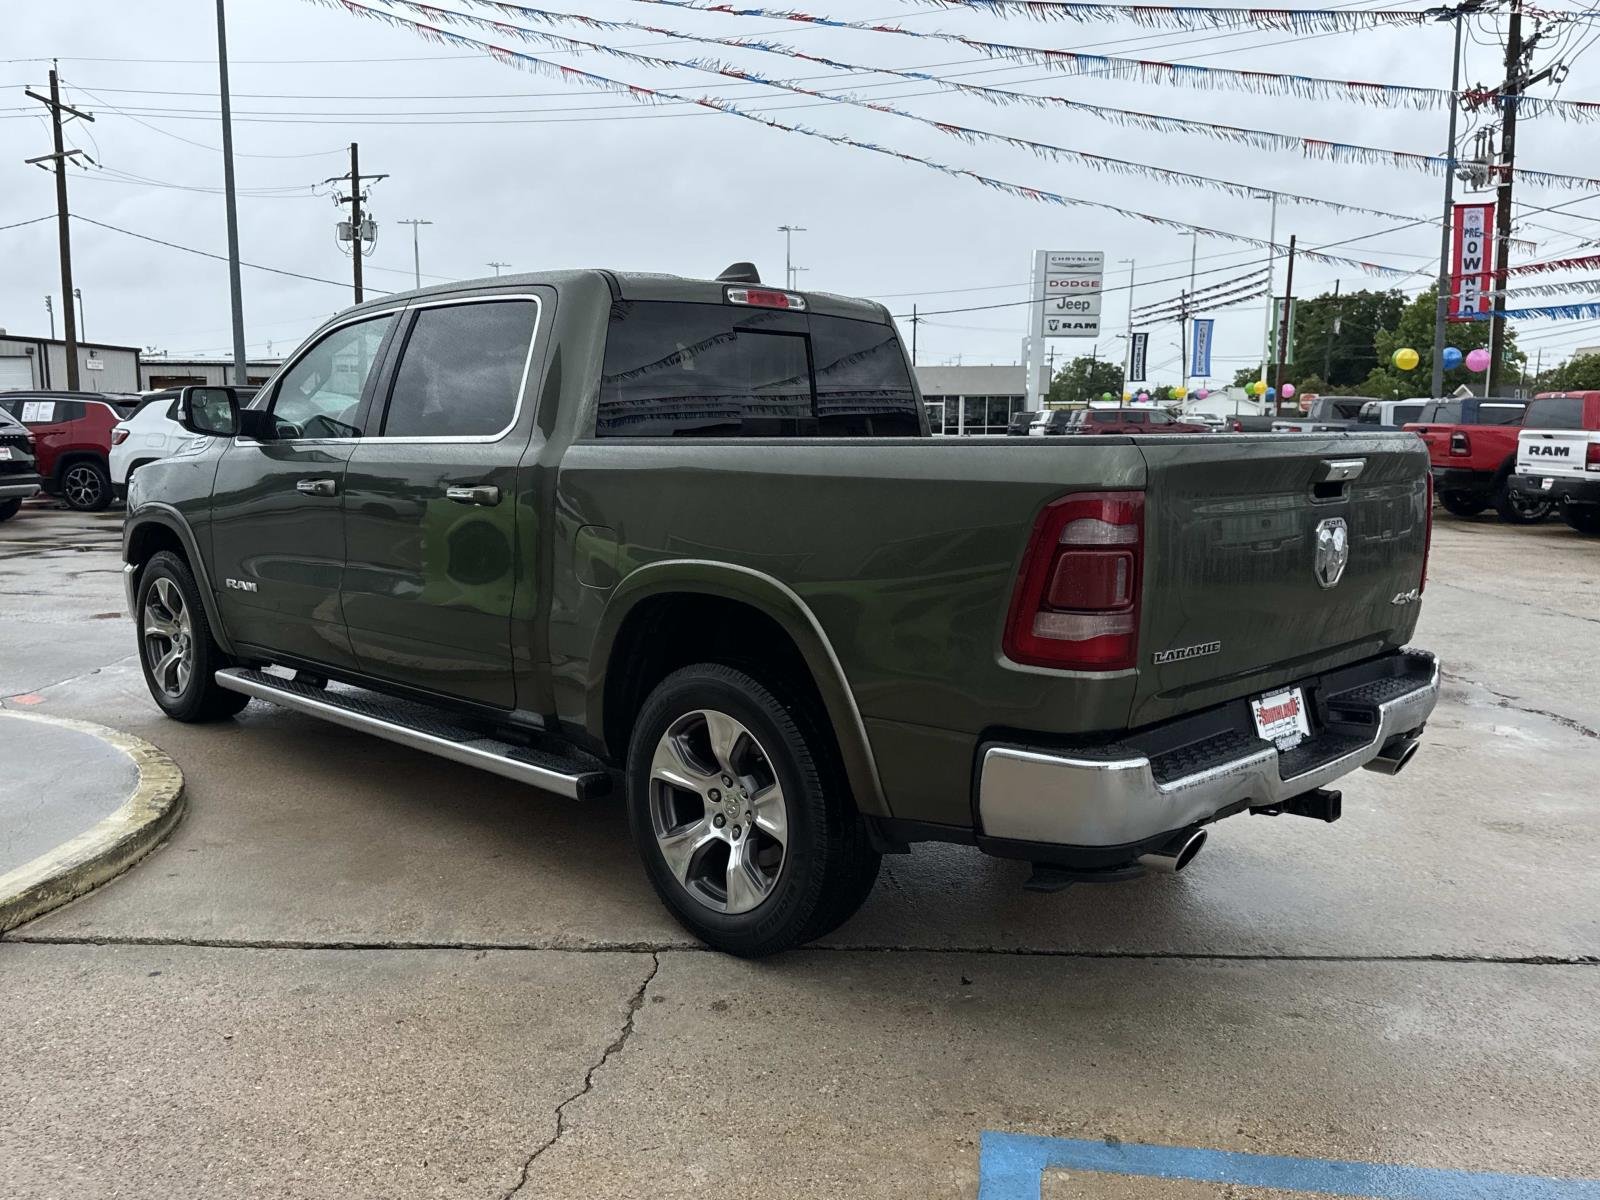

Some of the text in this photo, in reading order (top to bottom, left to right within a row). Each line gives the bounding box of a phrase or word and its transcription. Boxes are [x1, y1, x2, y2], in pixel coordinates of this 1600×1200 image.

[1049, 280, 1100, 288] DODGE
[1056, 297, 1091, 312] Jeep
[1528, 445, 1570, 457] RAM
[225, 578, 258, 592] RAM
[1153, 641, 1221, 664] LARAMIE
